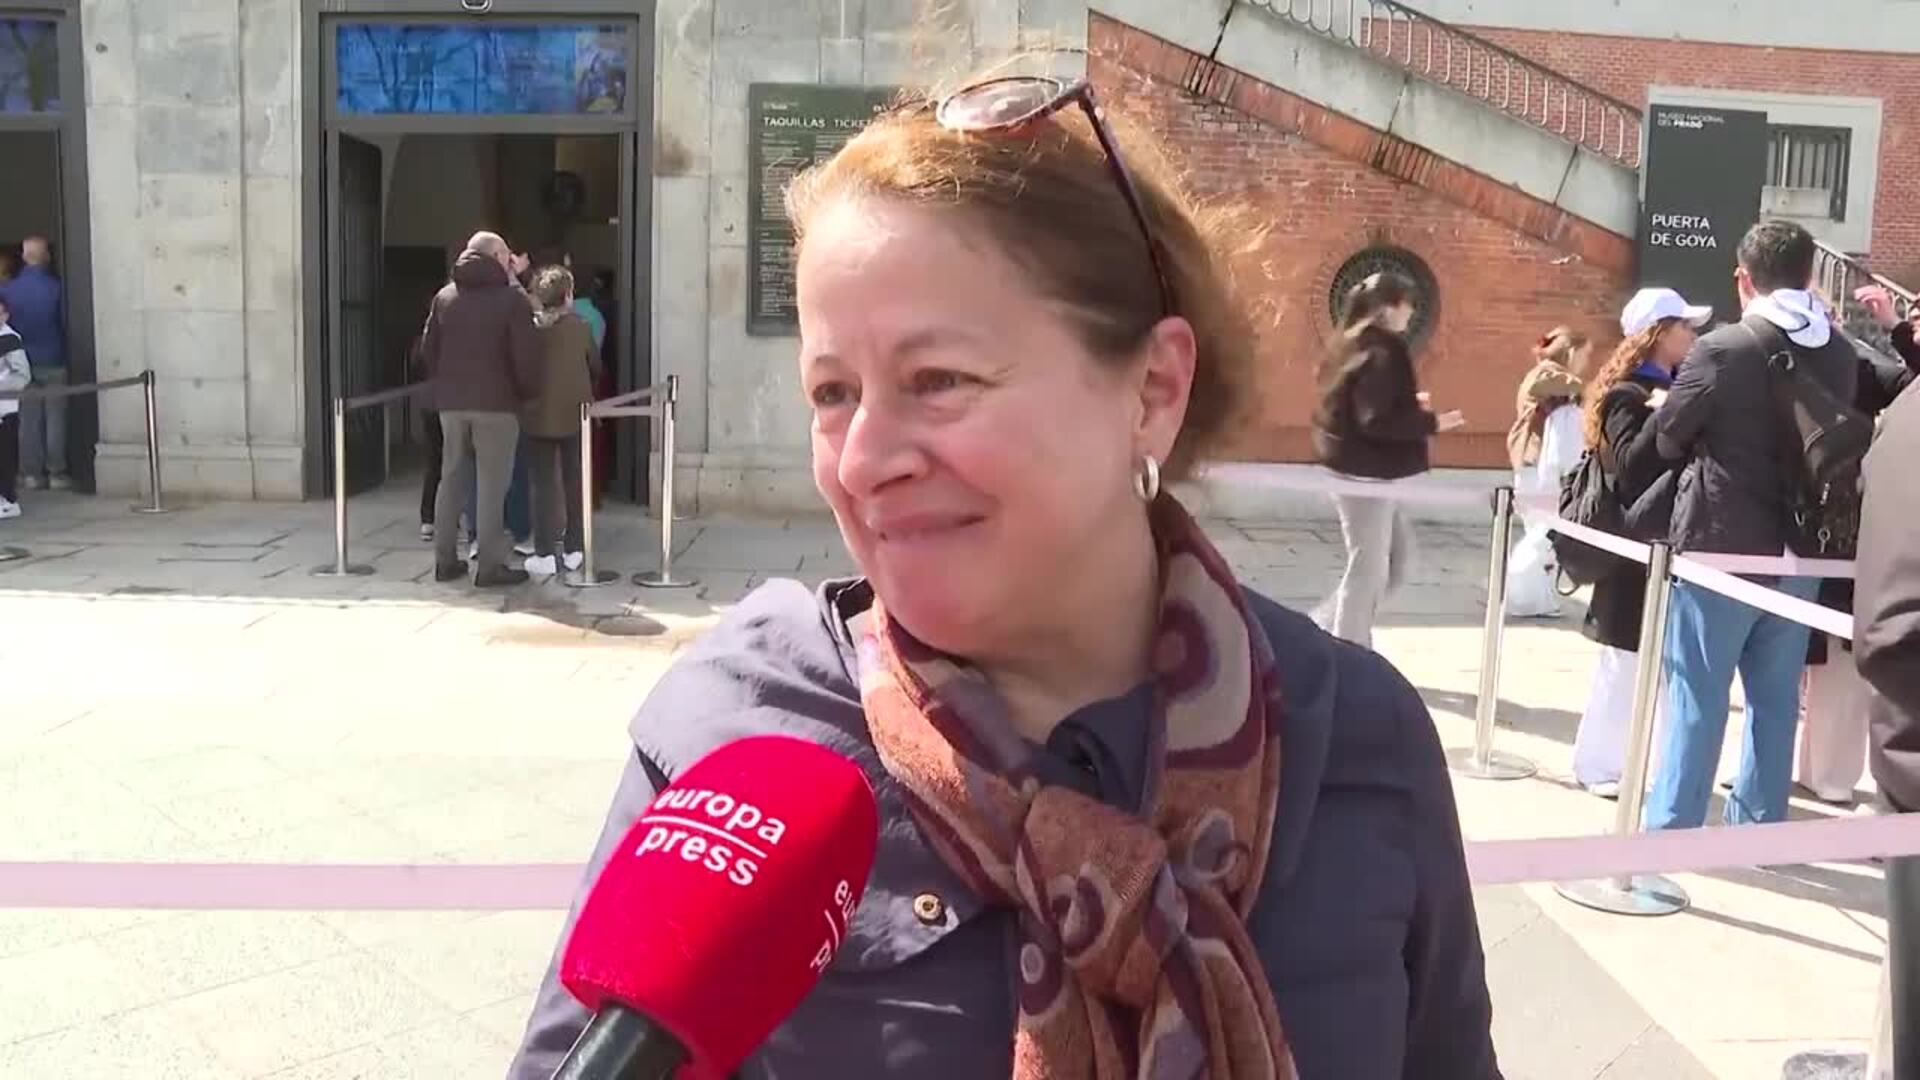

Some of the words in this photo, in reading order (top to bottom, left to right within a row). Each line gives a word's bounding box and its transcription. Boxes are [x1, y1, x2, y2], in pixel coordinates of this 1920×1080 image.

[763, 116, 826, 129] TAQUILLAS
[1673, 119, 1704, 129] PRADO
[1652, 214, 1710, 230] PUERTA
[1651, 232, 1670, 247] DE
[1674, 234, 1718, 249] GOYA
[653, 788, 786, 845] europa
[635, 826, 758, 886] press
